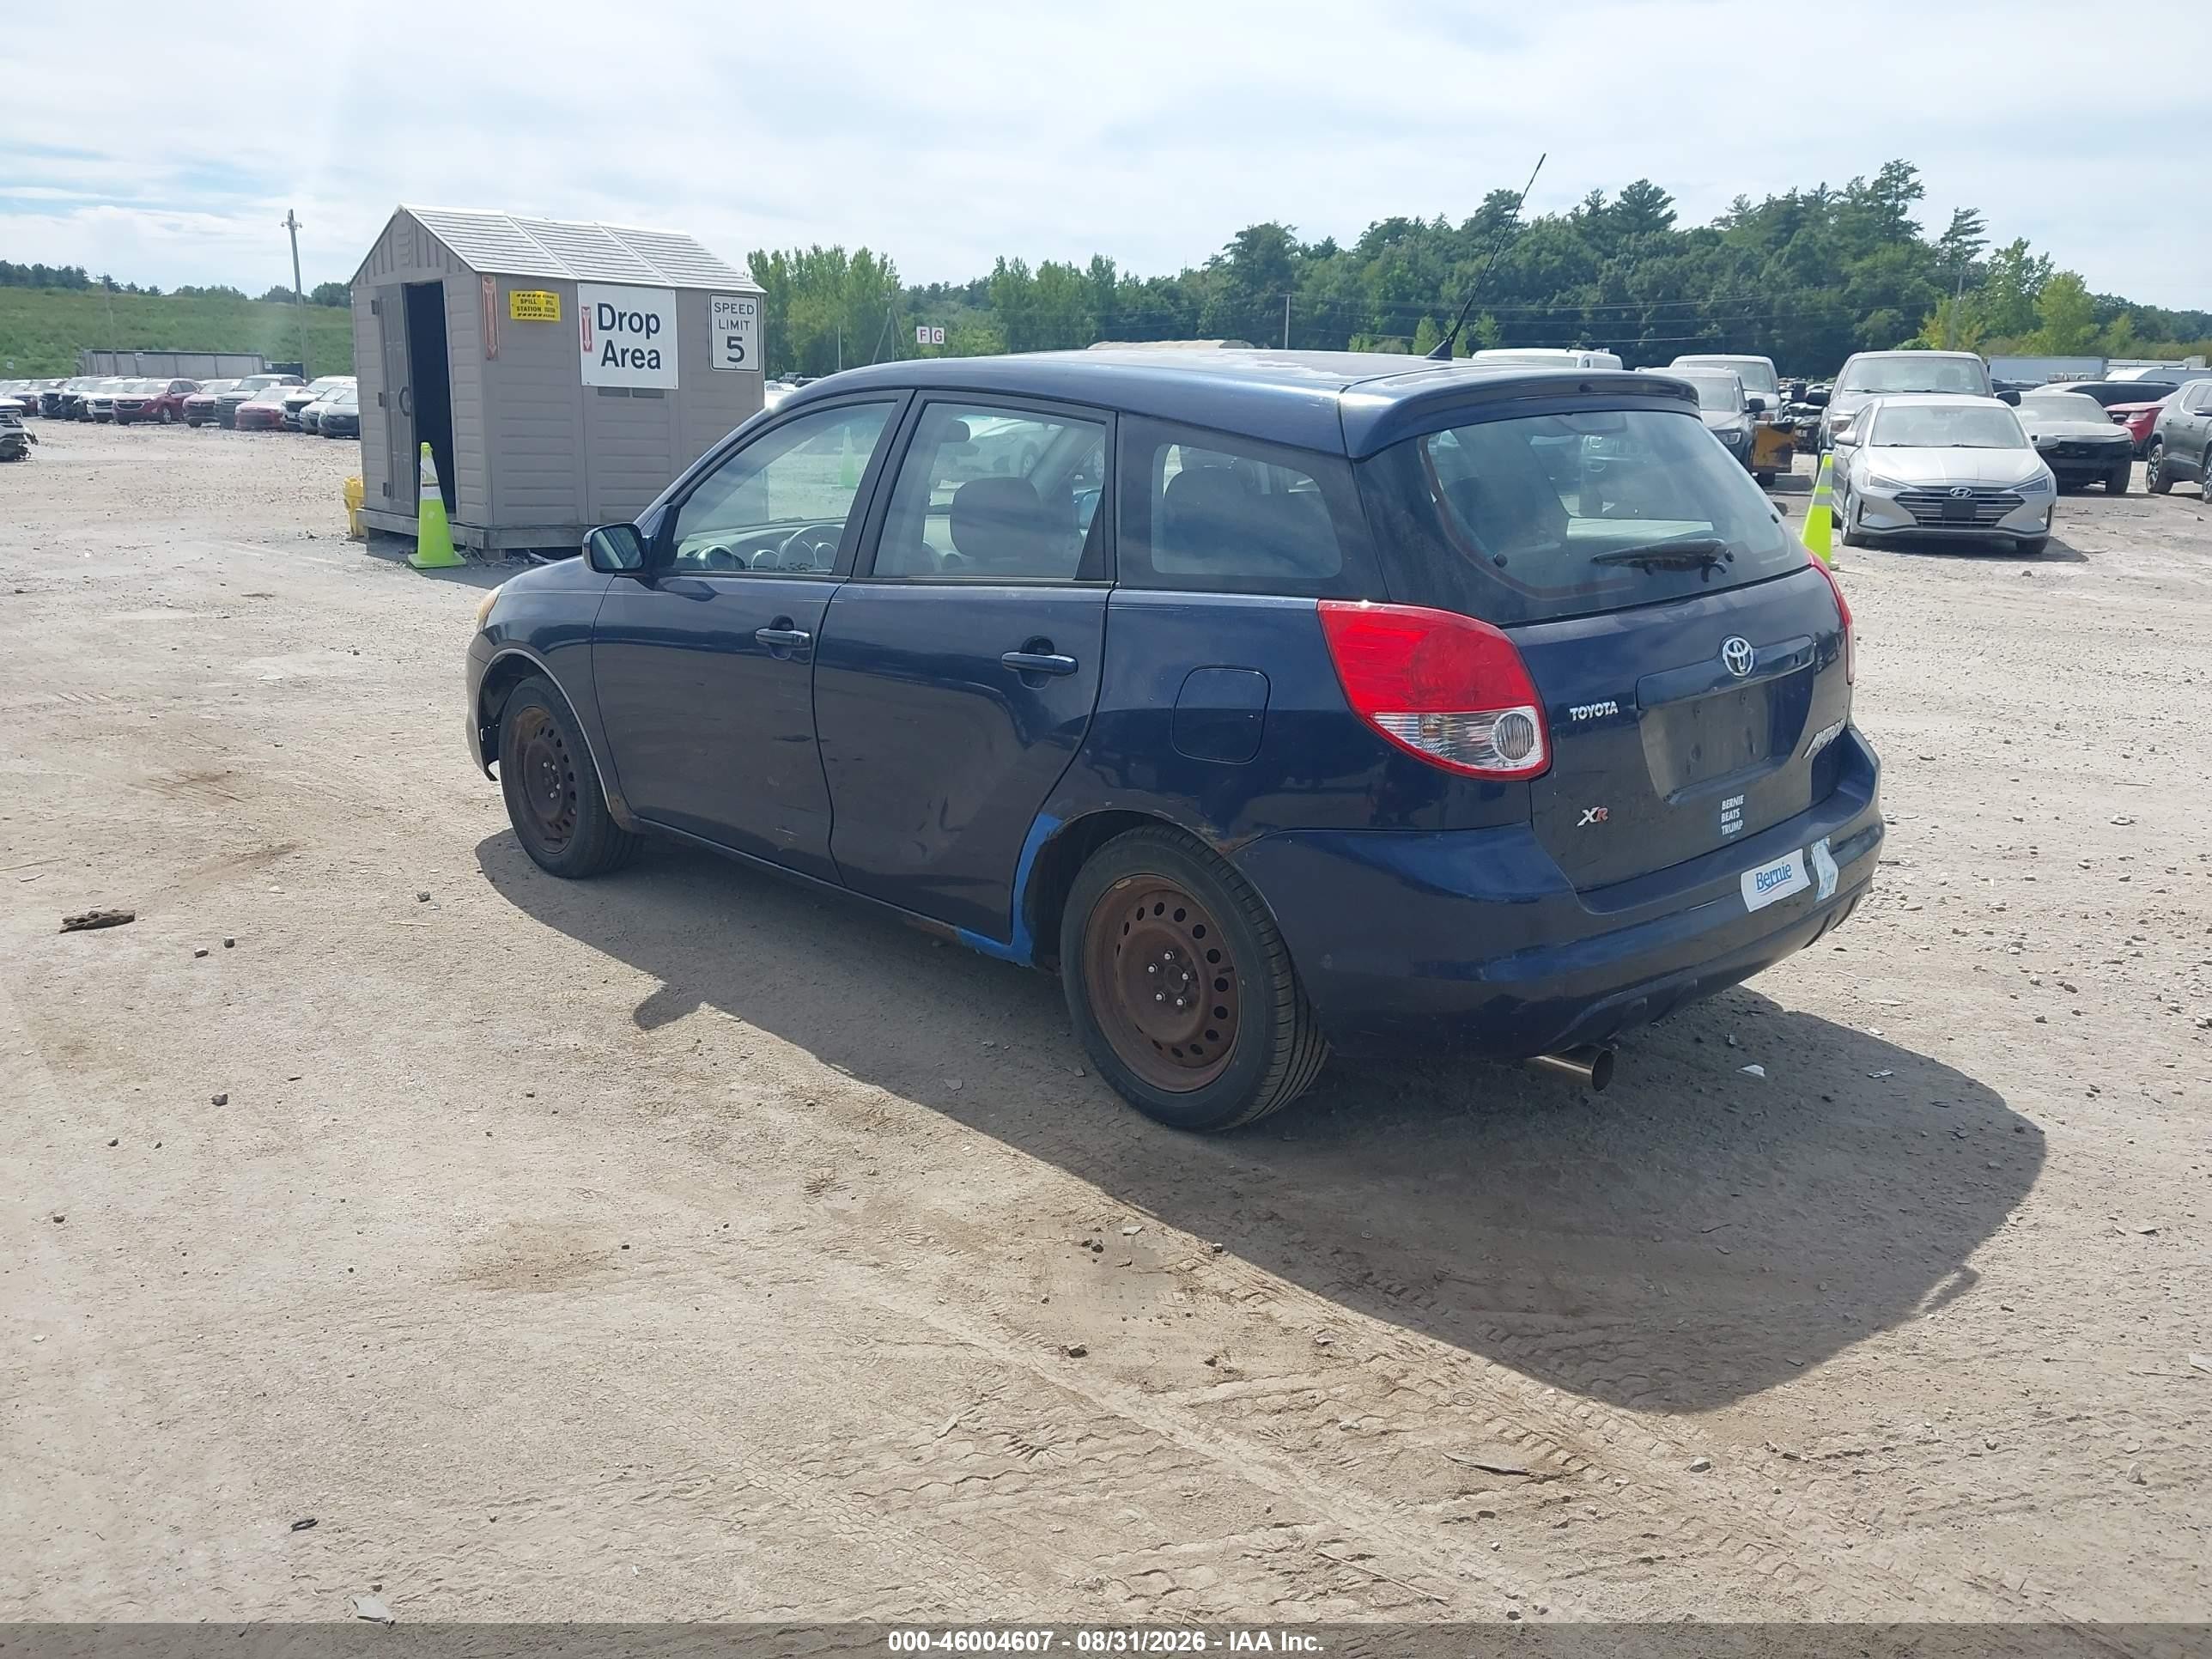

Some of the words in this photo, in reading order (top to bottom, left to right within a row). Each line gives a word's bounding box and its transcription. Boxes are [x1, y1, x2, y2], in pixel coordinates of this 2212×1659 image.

[714, 302, 755, 315] SPEED
[598, 303, 660, 339] Drop
[718, 319, 750, 331] LIMIT
[920, 329, 927, 341] F
[934, 330, 943, 342] G
[601, 339, 661, 370] Area
[726, 336, 745, 362] 5
[1569, 701, 1619, 721] TOYOTA
[1722, 794, 1745, 811] BERNIE
[1577, 806, 1608, 827] XR
[1721, 808, 1741, 823] BEATS
[1721, 819, 1743, 836] TRUMP
[1755, 862, 1792, 890] Bernie
